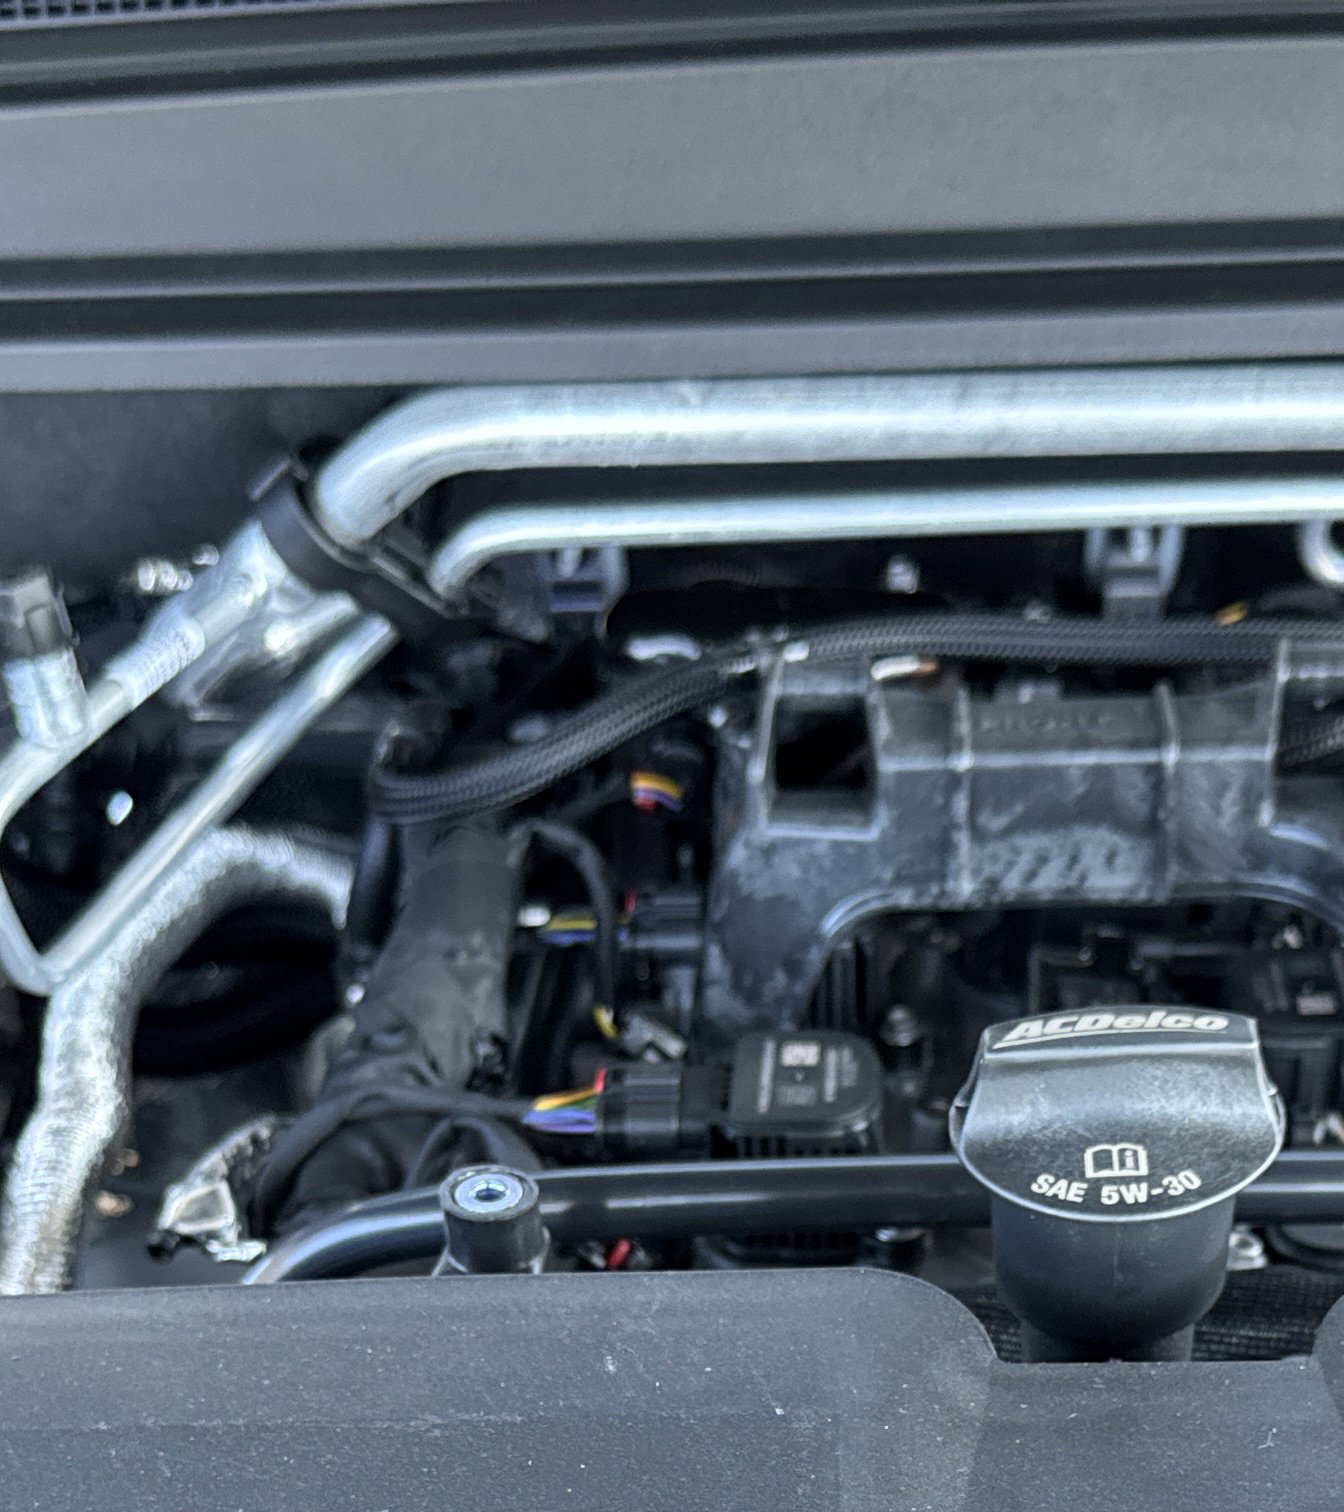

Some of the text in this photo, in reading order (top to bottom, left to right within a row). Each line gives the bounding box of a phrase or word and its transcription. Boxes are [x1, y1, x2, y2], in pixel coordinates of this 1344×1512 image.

[1000, 1010, 1229, 1043] ACDelco
[1030, 1169, 1202, 1205] SAE 5W-30
